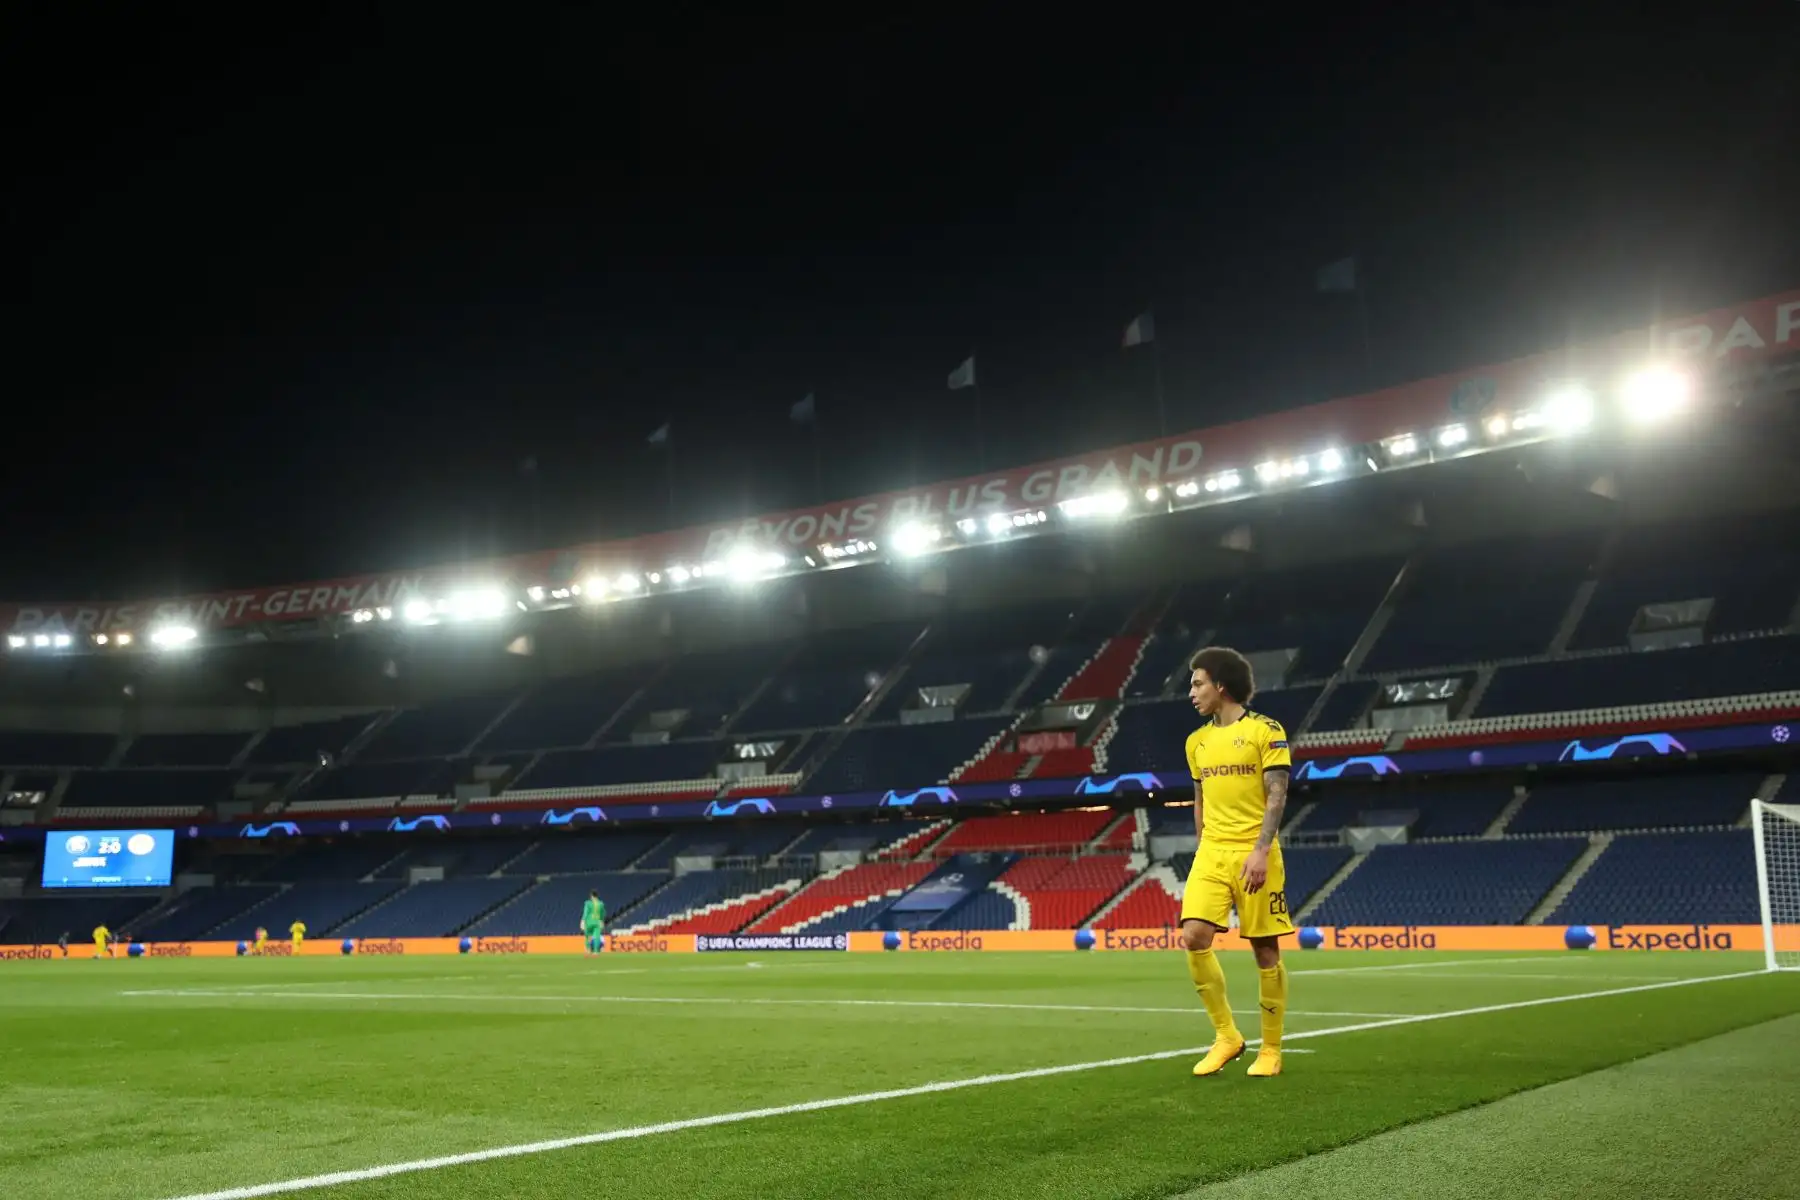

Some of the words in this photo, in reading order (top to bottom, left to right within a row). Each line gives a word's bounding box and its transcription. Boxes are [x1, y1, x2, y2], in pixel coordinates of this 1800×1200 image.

[1021, 441, 1202, 500] GRAND
[13, 606, 138, 632] PARIS
[153, 576, 421, 626] SAINT-GERMAIN
[1269, 891, 1287, 914] 28
[476, 936, 528, 953] Expedia
[610, 929, 668, 951] Expedia
[709, 937, 734, 949] UEFA
[735, 936, 793, 949] CHAMPIONS
[795, 936, 833, 948] LEAGUE
[909, 930, 983, 950] Expedia
[1334, 928, 1436, 949] Expedia
[1609, 926, 1732, 950] Expedia
